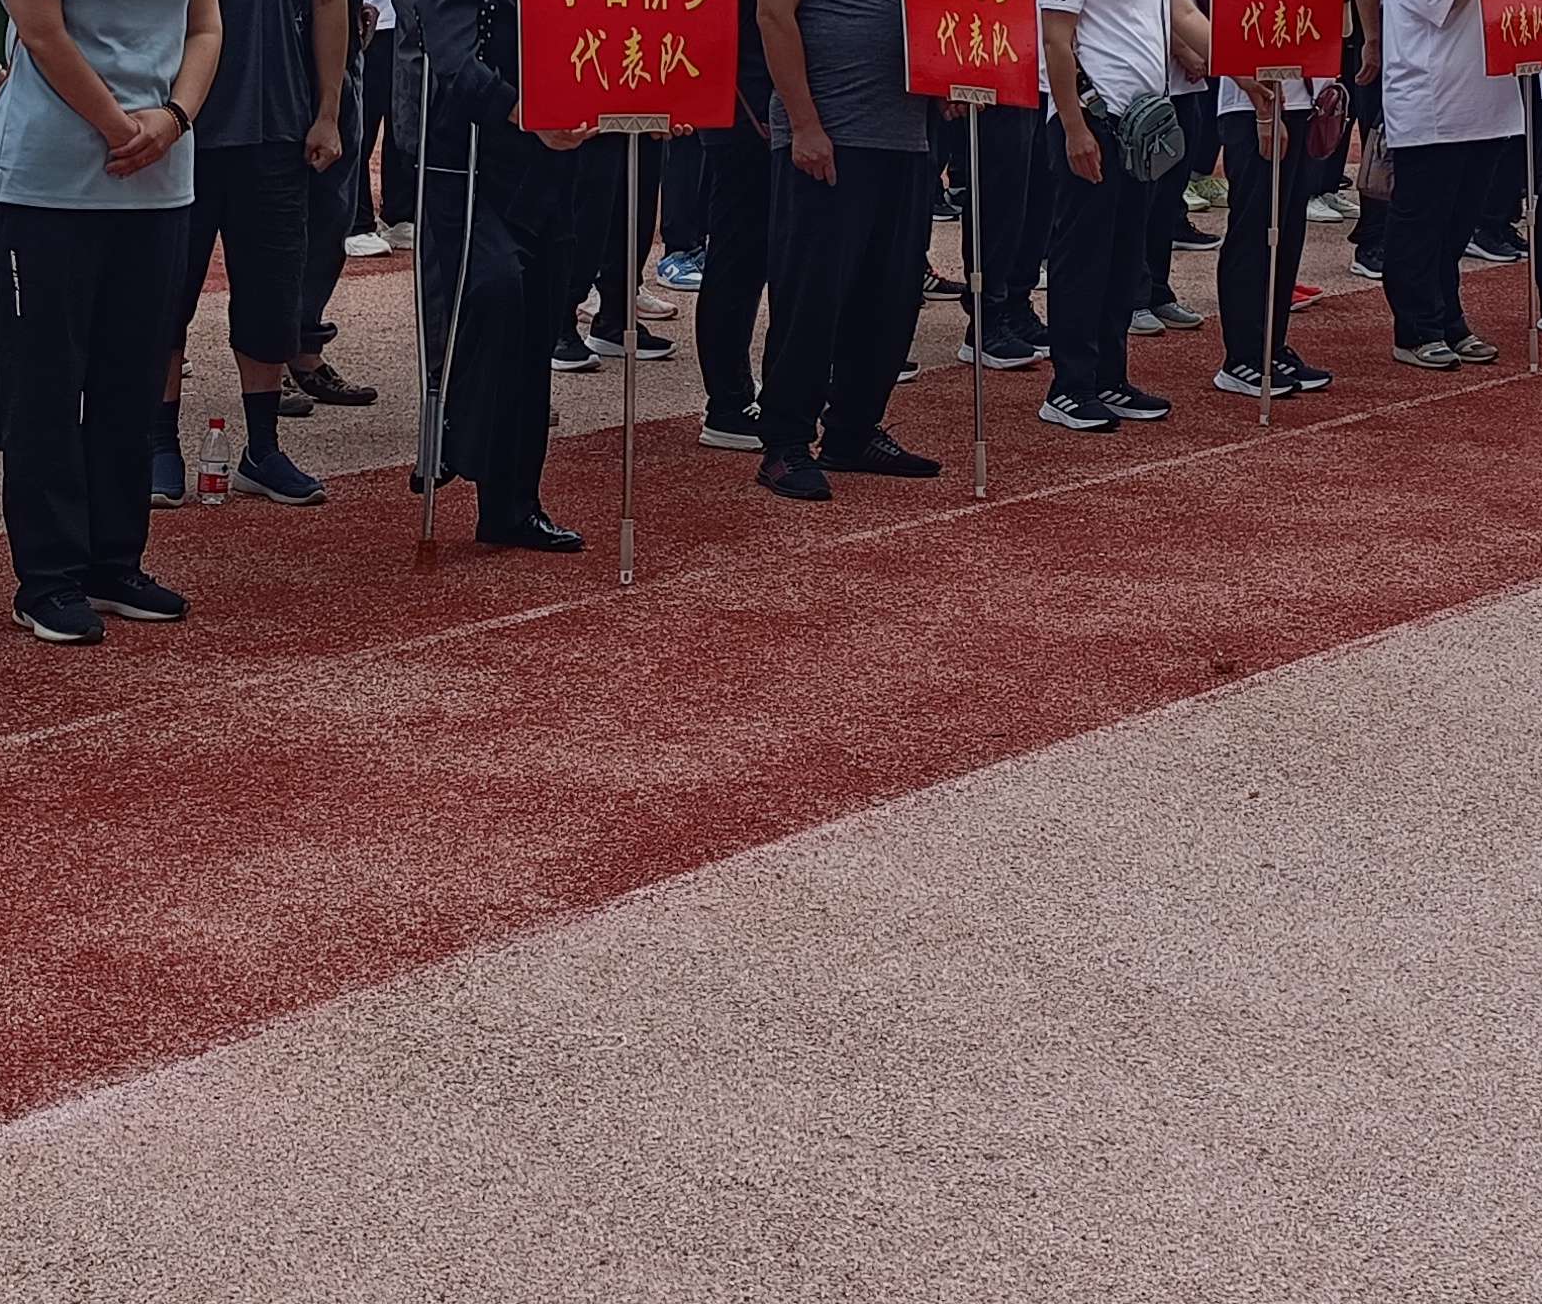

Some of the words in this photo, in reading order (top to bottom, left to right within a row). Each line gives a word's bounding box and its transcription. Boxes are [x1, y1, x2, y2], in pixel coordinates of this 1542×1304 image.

[937, 10, 1019, 67] 代表队
[1241, 0, 1321, 49] 代表队
[570, 26, 700, 91] 代表队
